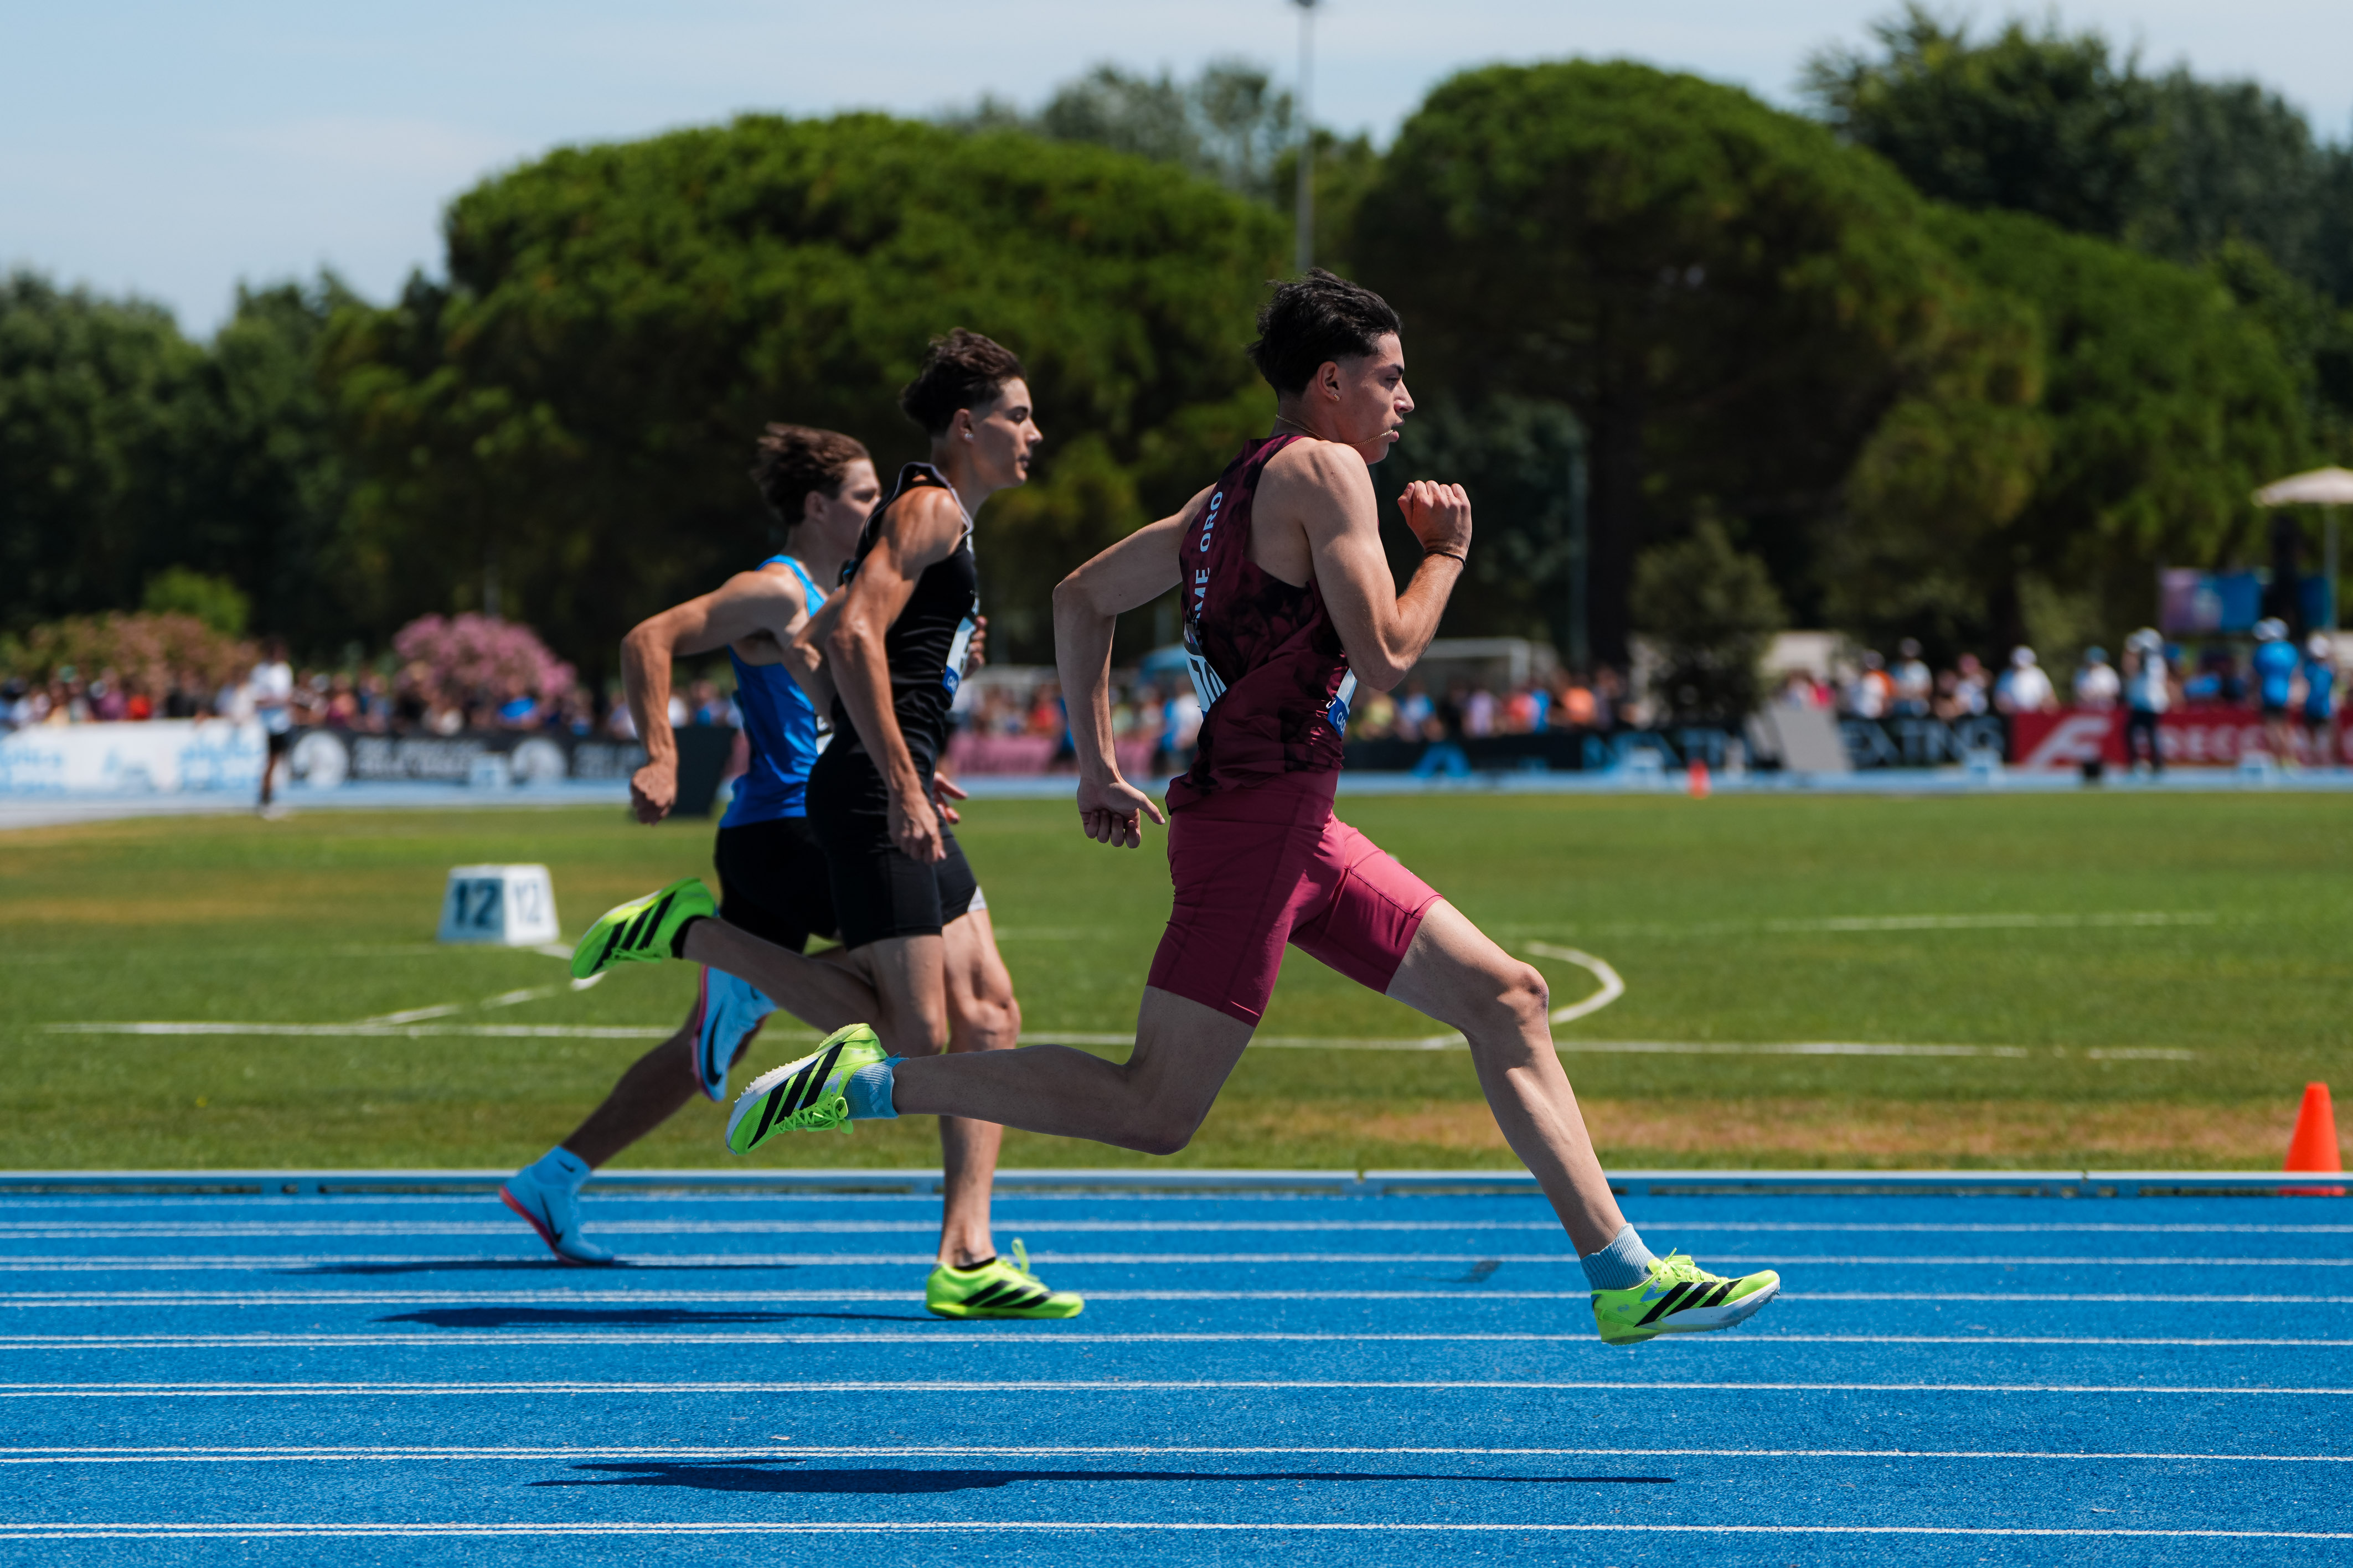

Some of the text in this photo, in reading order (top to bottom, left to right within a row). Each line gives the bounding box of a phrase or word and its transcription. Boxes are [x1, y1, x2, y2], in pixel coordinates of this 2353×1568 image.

[1200, 491, 1222, 552] ORO
[453, 880, 499, 928] 12
[514, 883, 542, 924] 12
